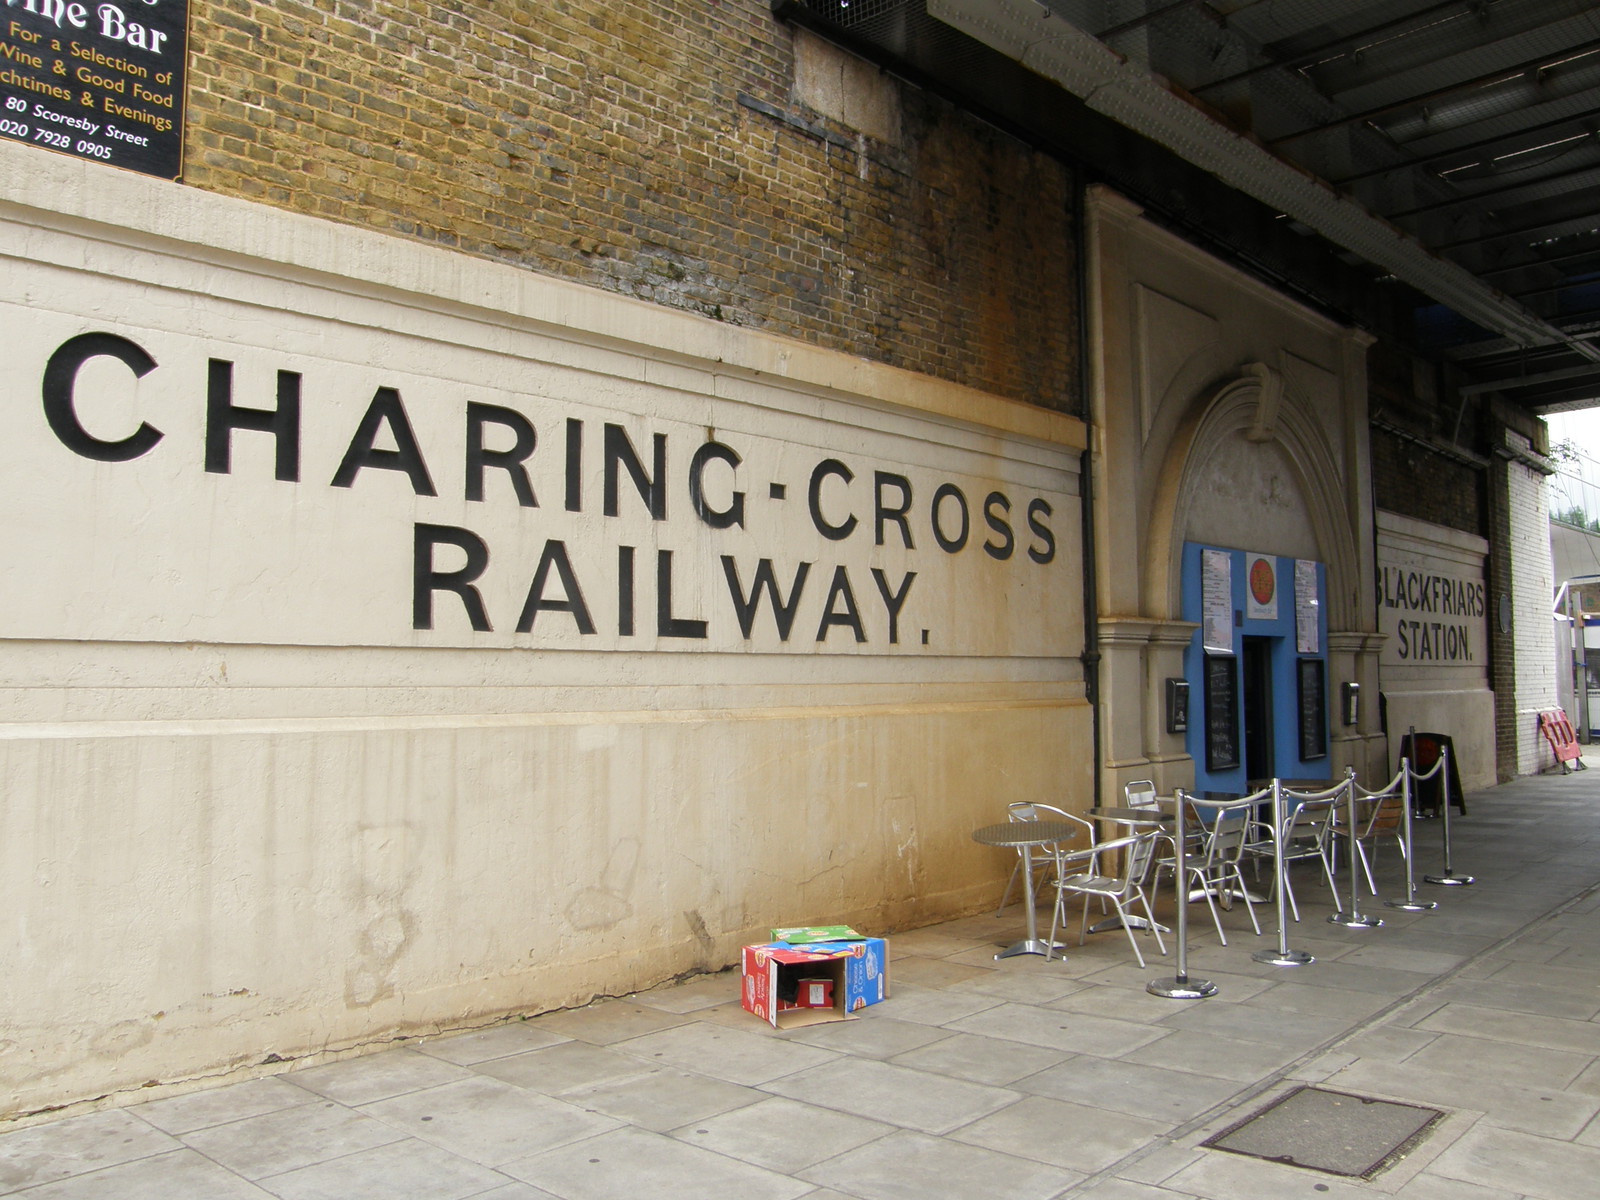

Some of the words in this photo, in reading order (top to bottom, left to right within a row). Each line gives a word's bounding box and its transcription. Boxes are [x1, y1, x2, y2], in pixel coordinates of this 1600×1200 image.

[10, 20, 43, 44] For
[51, 38, 62, 52] a
[70, 41, 148, 79] Selection
[155, 72, 173, 86] of
[98, 3, 168, 54] Bar
[53, 59, 67, 77] &
[77, 66, 125, 94] Good
[133, 83, 174, 109] Food
[5, 96, 28, 113] 80
[33, 104, 100, 136] Scoresby
[105, 124, 149, 148] Street
[81, 91, 95, 108] &
[104, 97, 173, 132] Evenings
[0, 119, 29, 137] 020
[34, 128, 71, 149] 7928
[76, 140, 113, 160] 0905
[1397, 618, 1473, 661] STATION.
